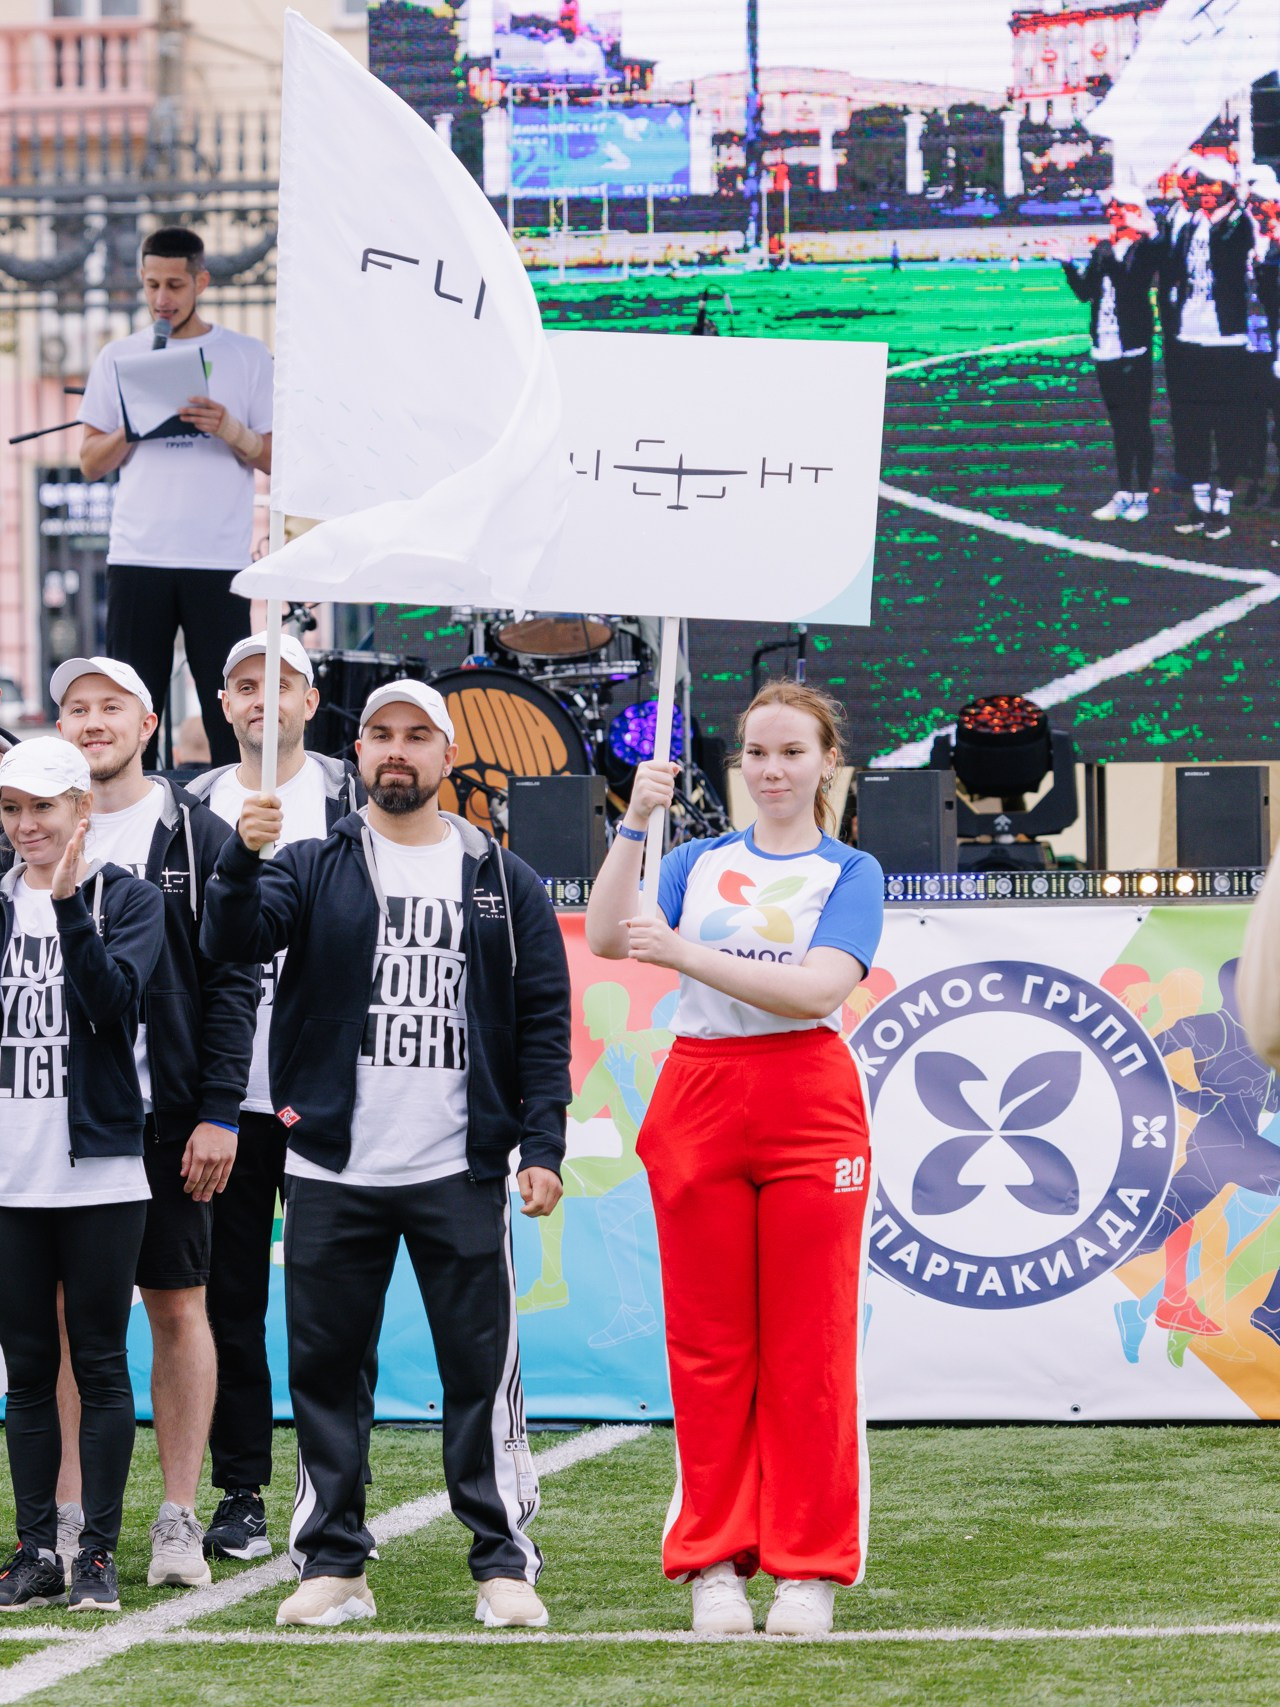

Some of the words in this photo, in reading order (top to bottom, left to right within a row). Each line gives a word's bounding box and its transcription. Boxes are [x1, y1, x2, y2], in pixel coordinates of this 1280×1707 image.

[361, 247, 486, 320] FLI
[1, 932, 63, 982] NJO
[0, 984, 70, 1038] YOU
[858, 973, 1005, 1077] КОМОС
[1021, 974, 1148, 1077] ГРУПП
[835, 1155, 866, 1187] 20
